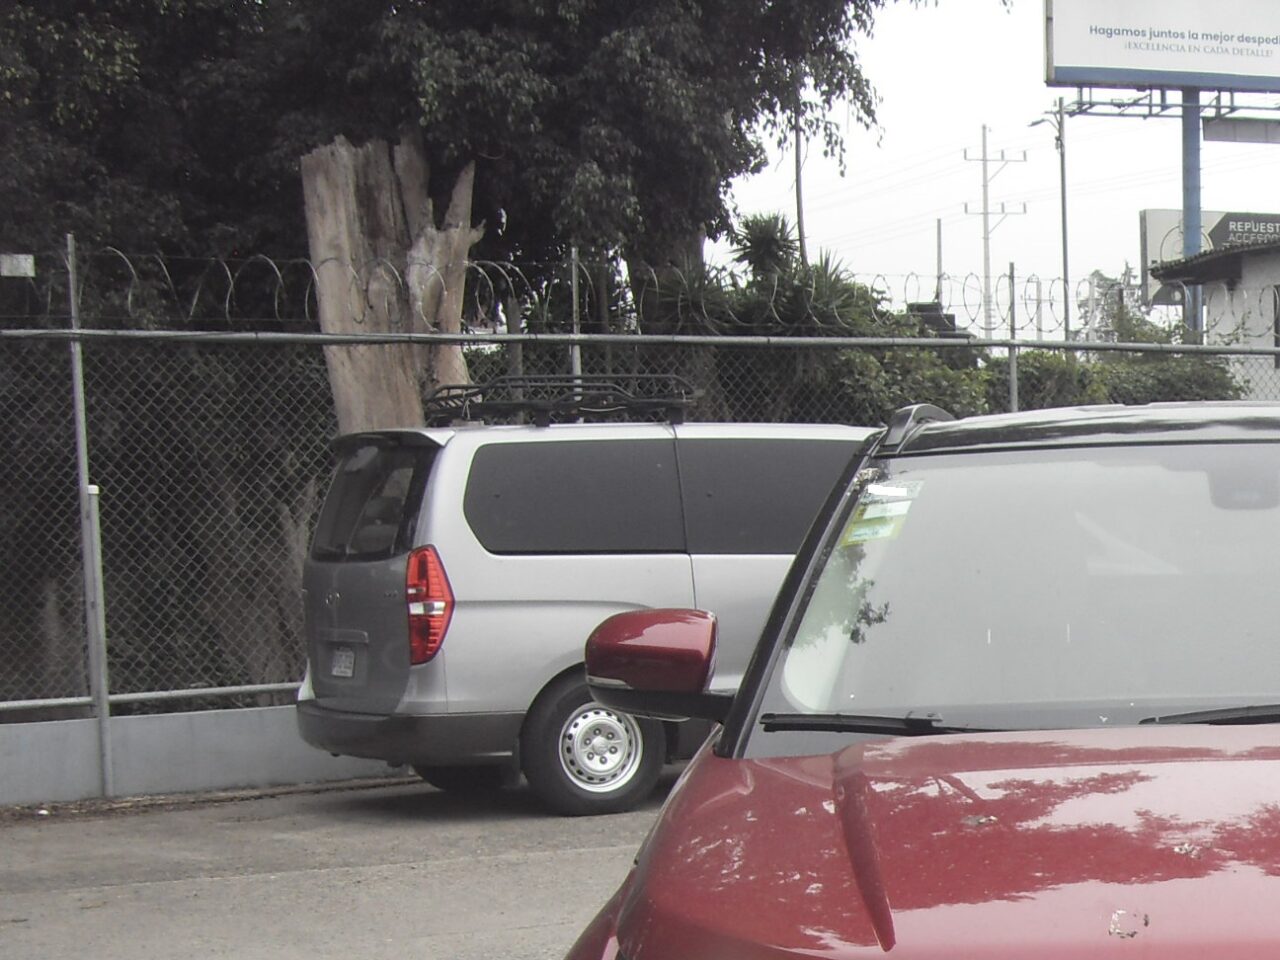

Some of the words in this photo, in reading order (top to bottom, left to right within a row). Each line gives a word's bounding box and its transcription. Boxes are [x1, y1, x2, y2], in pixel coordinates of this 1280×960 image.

[1089, 24, 1147, 38] Hagamos
[1149, 27, 1185, 40] juntos
[1188, 30, 1199, 40] la
[1201, 32, 1235, 44] mejor
[1188, 44, 1201, 53] EN
[1203, 46, 1230, 55] CADA
